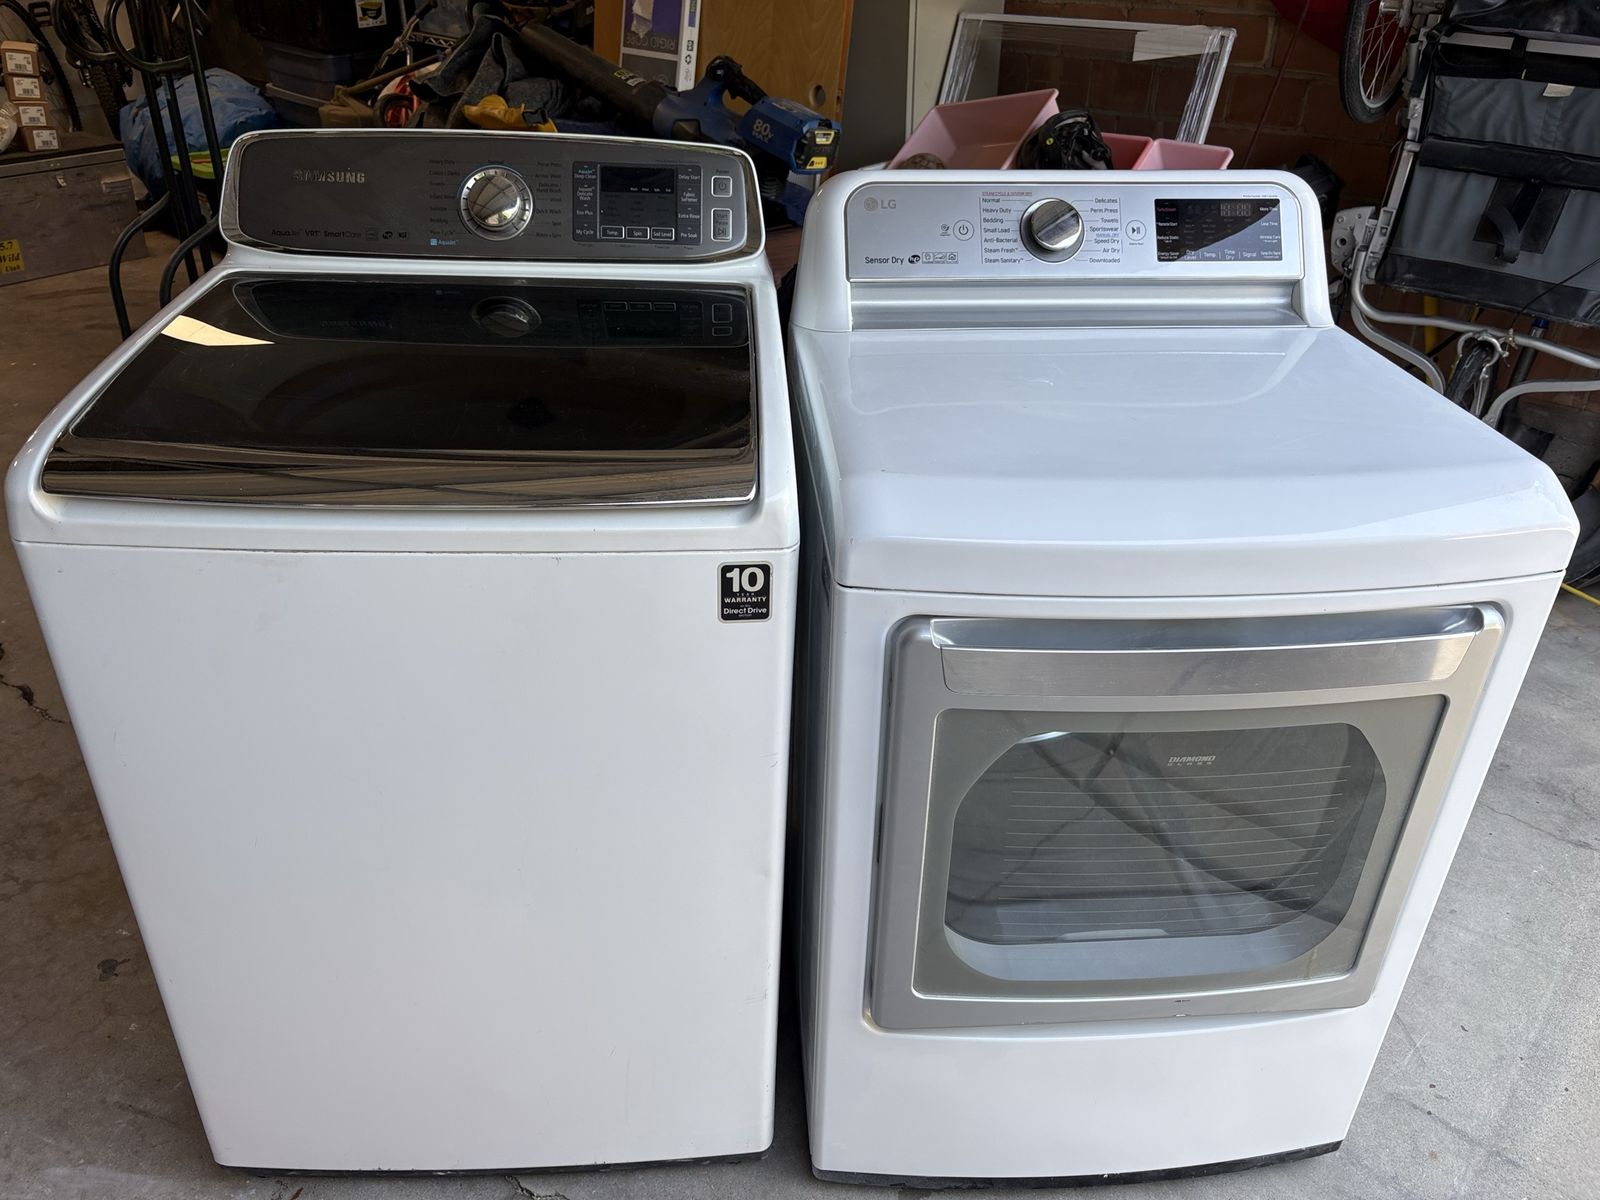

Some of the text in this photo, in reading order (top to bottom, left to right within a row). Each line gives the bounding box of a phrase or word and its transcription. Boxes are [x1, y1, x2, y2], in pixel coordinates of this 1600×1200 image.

[292, 168, 365, 183] SAMSUNG
[881, 200, 897, 209] LG
[865, 256, 904, 265] Sensor Dry
[726, 567, 765, 592] 10
